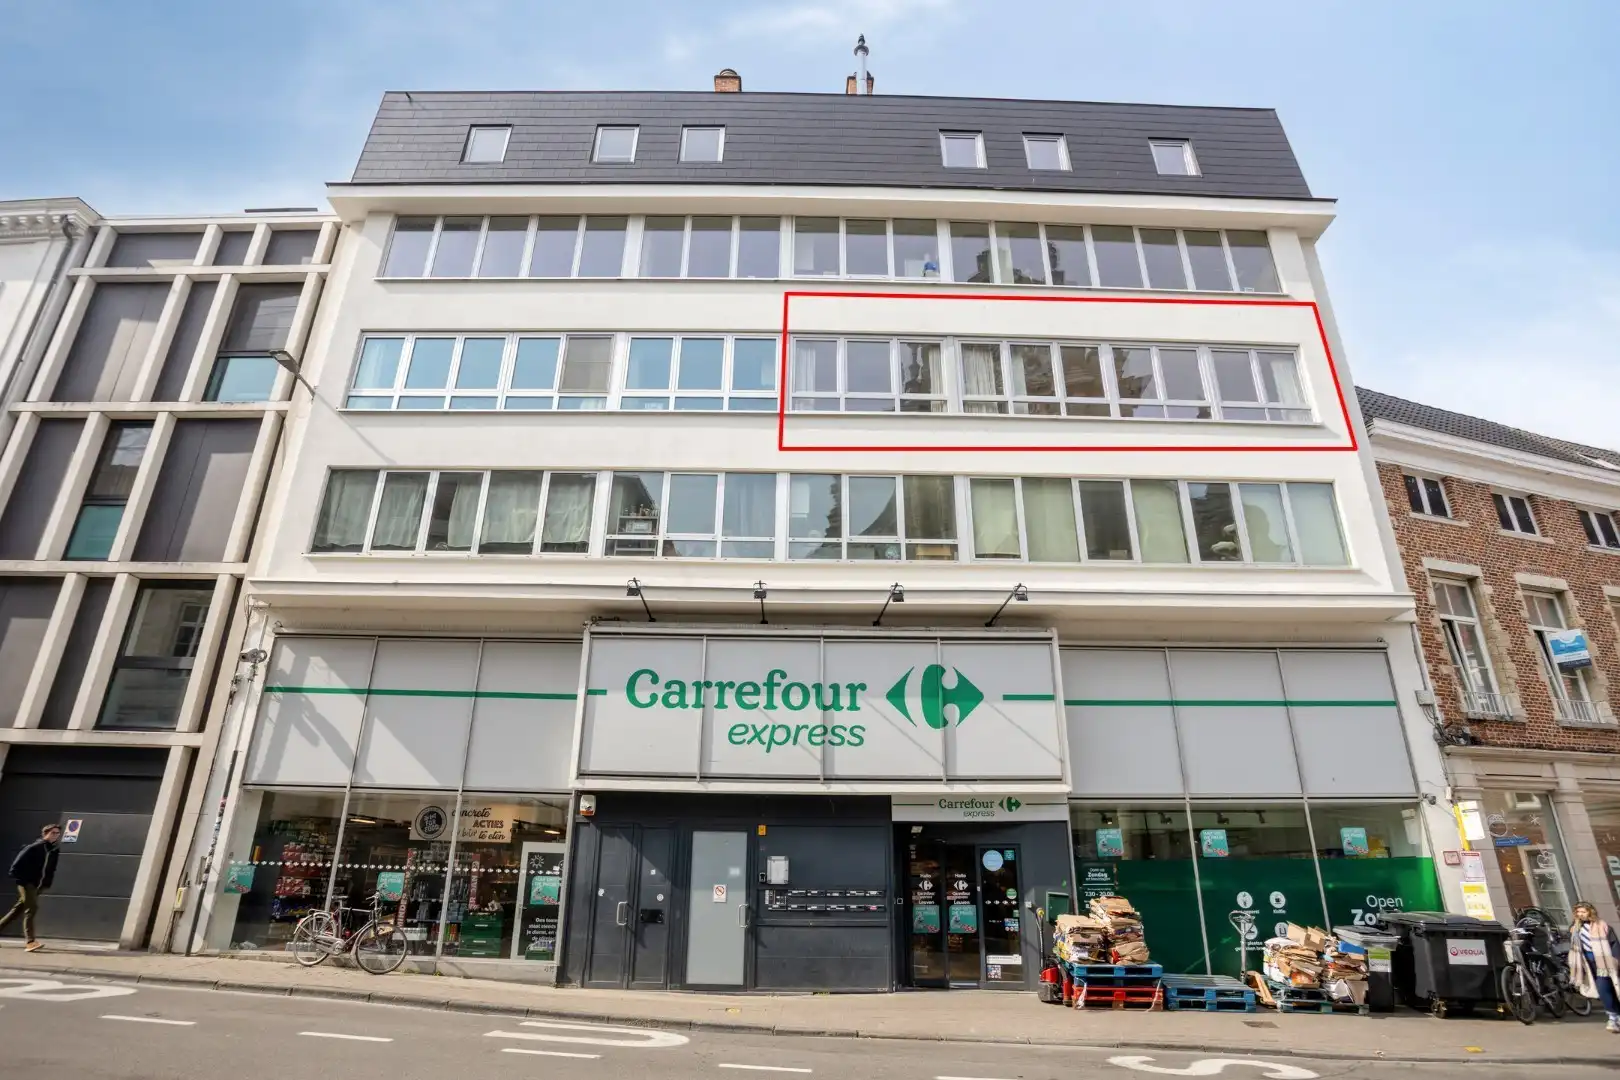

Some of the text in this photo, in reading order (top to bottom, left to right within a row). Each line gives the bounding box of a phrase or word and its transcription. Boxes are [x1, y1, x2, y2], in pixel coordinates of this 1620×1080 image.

[626, 668, 867, 712] Carrefour
[727, 722, 866, 754] express
[938, 798, 995, 809] Carrefour
[452, 806, 491, 818] cncrete
[963, 810, 995, 818] express
[472, 820, 504, 829] ACTIES
[1366, 895, 1404, 910] Open
[1459, 948, 1485, 956] VEOLIA
